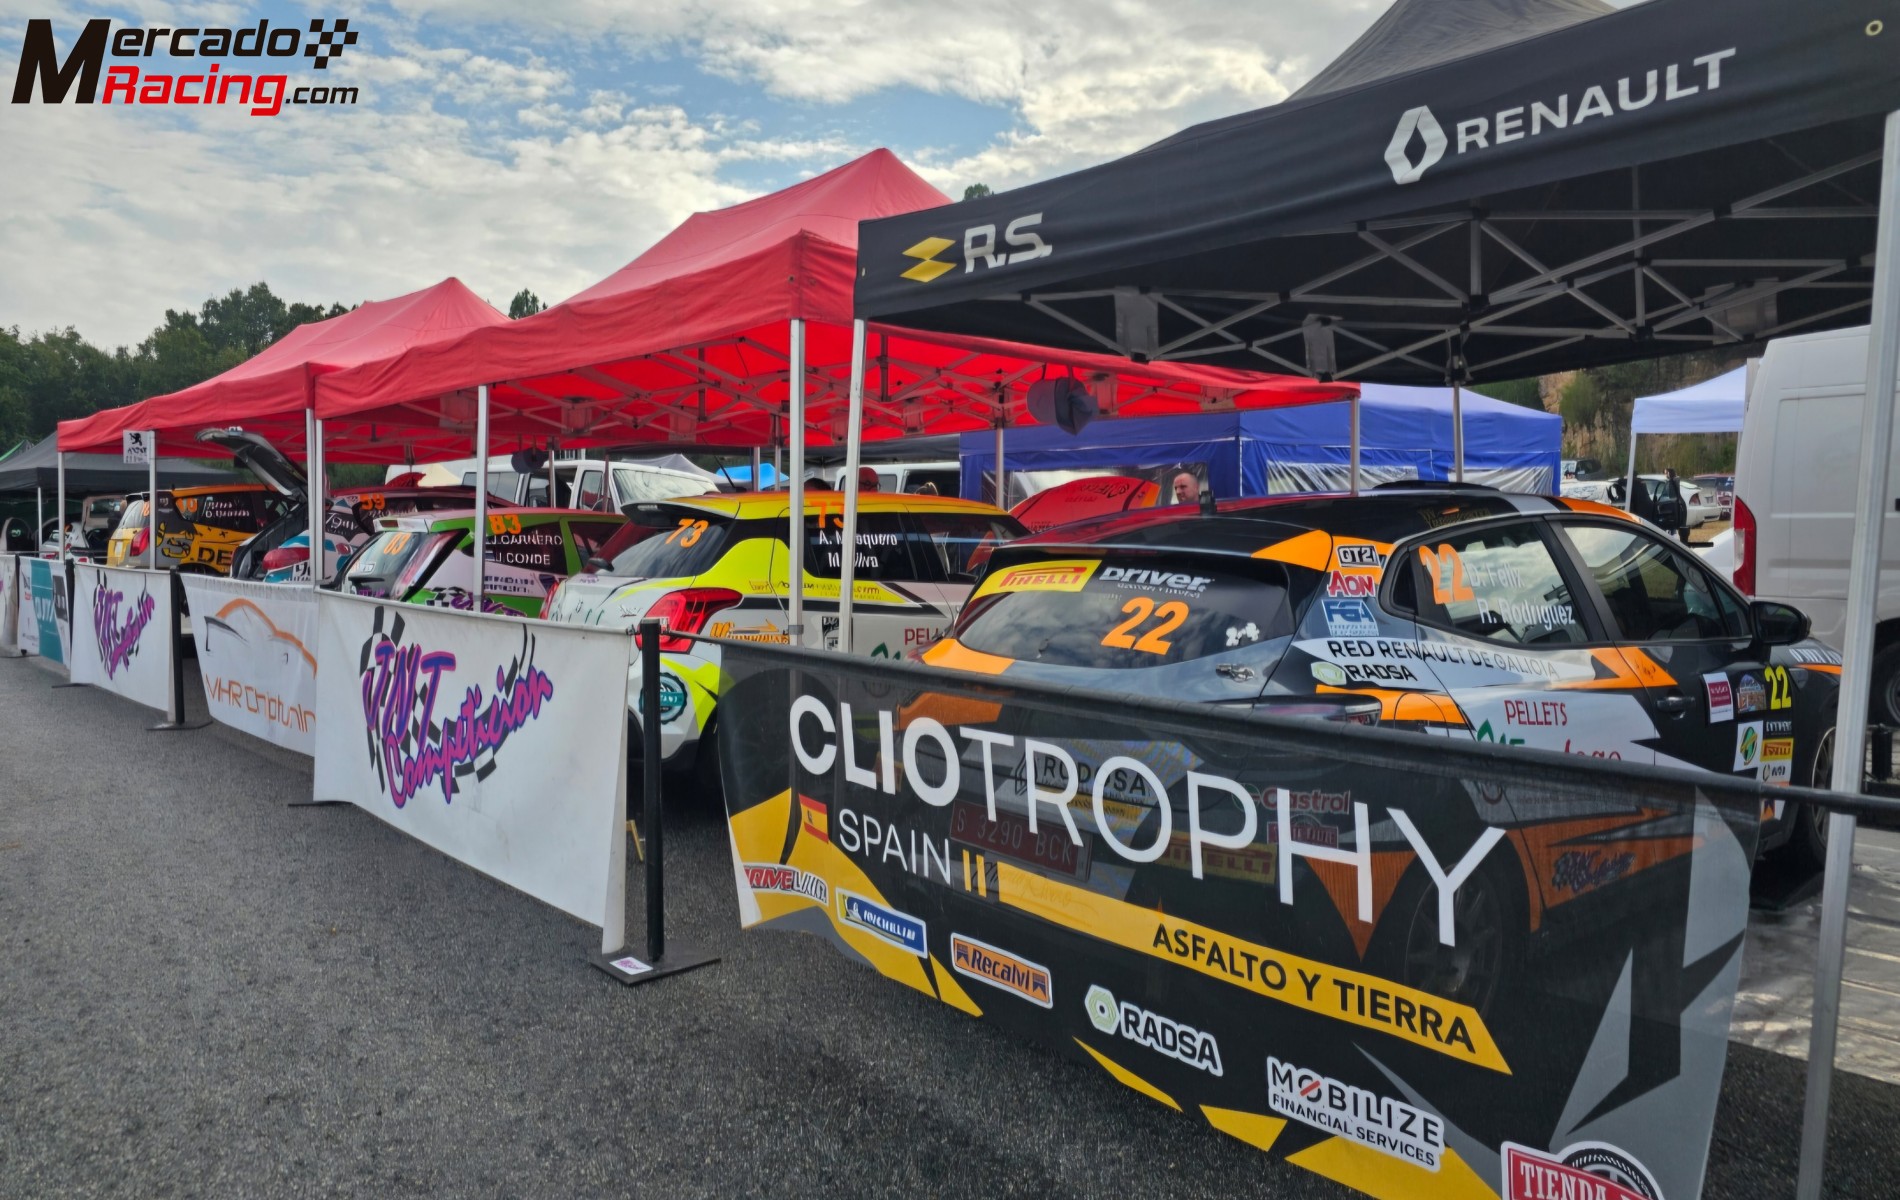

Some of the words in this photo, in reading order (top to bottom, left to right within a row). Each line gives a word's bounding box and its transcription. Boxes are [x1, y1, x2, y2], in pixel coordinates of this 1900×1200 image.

[1456, 47, 1737, 154] RENAULT
[488, 513, 522, 535] 83
[664, 518, 709, 549] 73
[999, 566, 1087, 588] PIRELLI
[1418, 543, 1474, 605] 22
[1101, 597, 1190, 655] 22
[1327, 640, 1375, 658] RED
[1377, 640, 1466, 664] RENAULT
[1466, 650, 1494, 668] DE
[1344, 664, 1419, 682] RADSA
[1504, 699, 1568, 726] PELLETS
[1764, 665, 1792, 710] 22
[838, 807, 953, 886] SPAIN
[1152, 923, 1287, 991] ASFALTO
[1296, 968, 1322, 1002] Y
[1333, 978, 1477, 1054] TIERRA
[1123, 1006, 1219, 1071] RADSA
[1271, 1061, 1440, 1148] MOBILIZE
[1273, 1093, 1352, 1136] FINANCIAL
[1356, 1126, 1435, 1167] SERVICES
[1519, 1160, 1607, 1200] TIENDA
